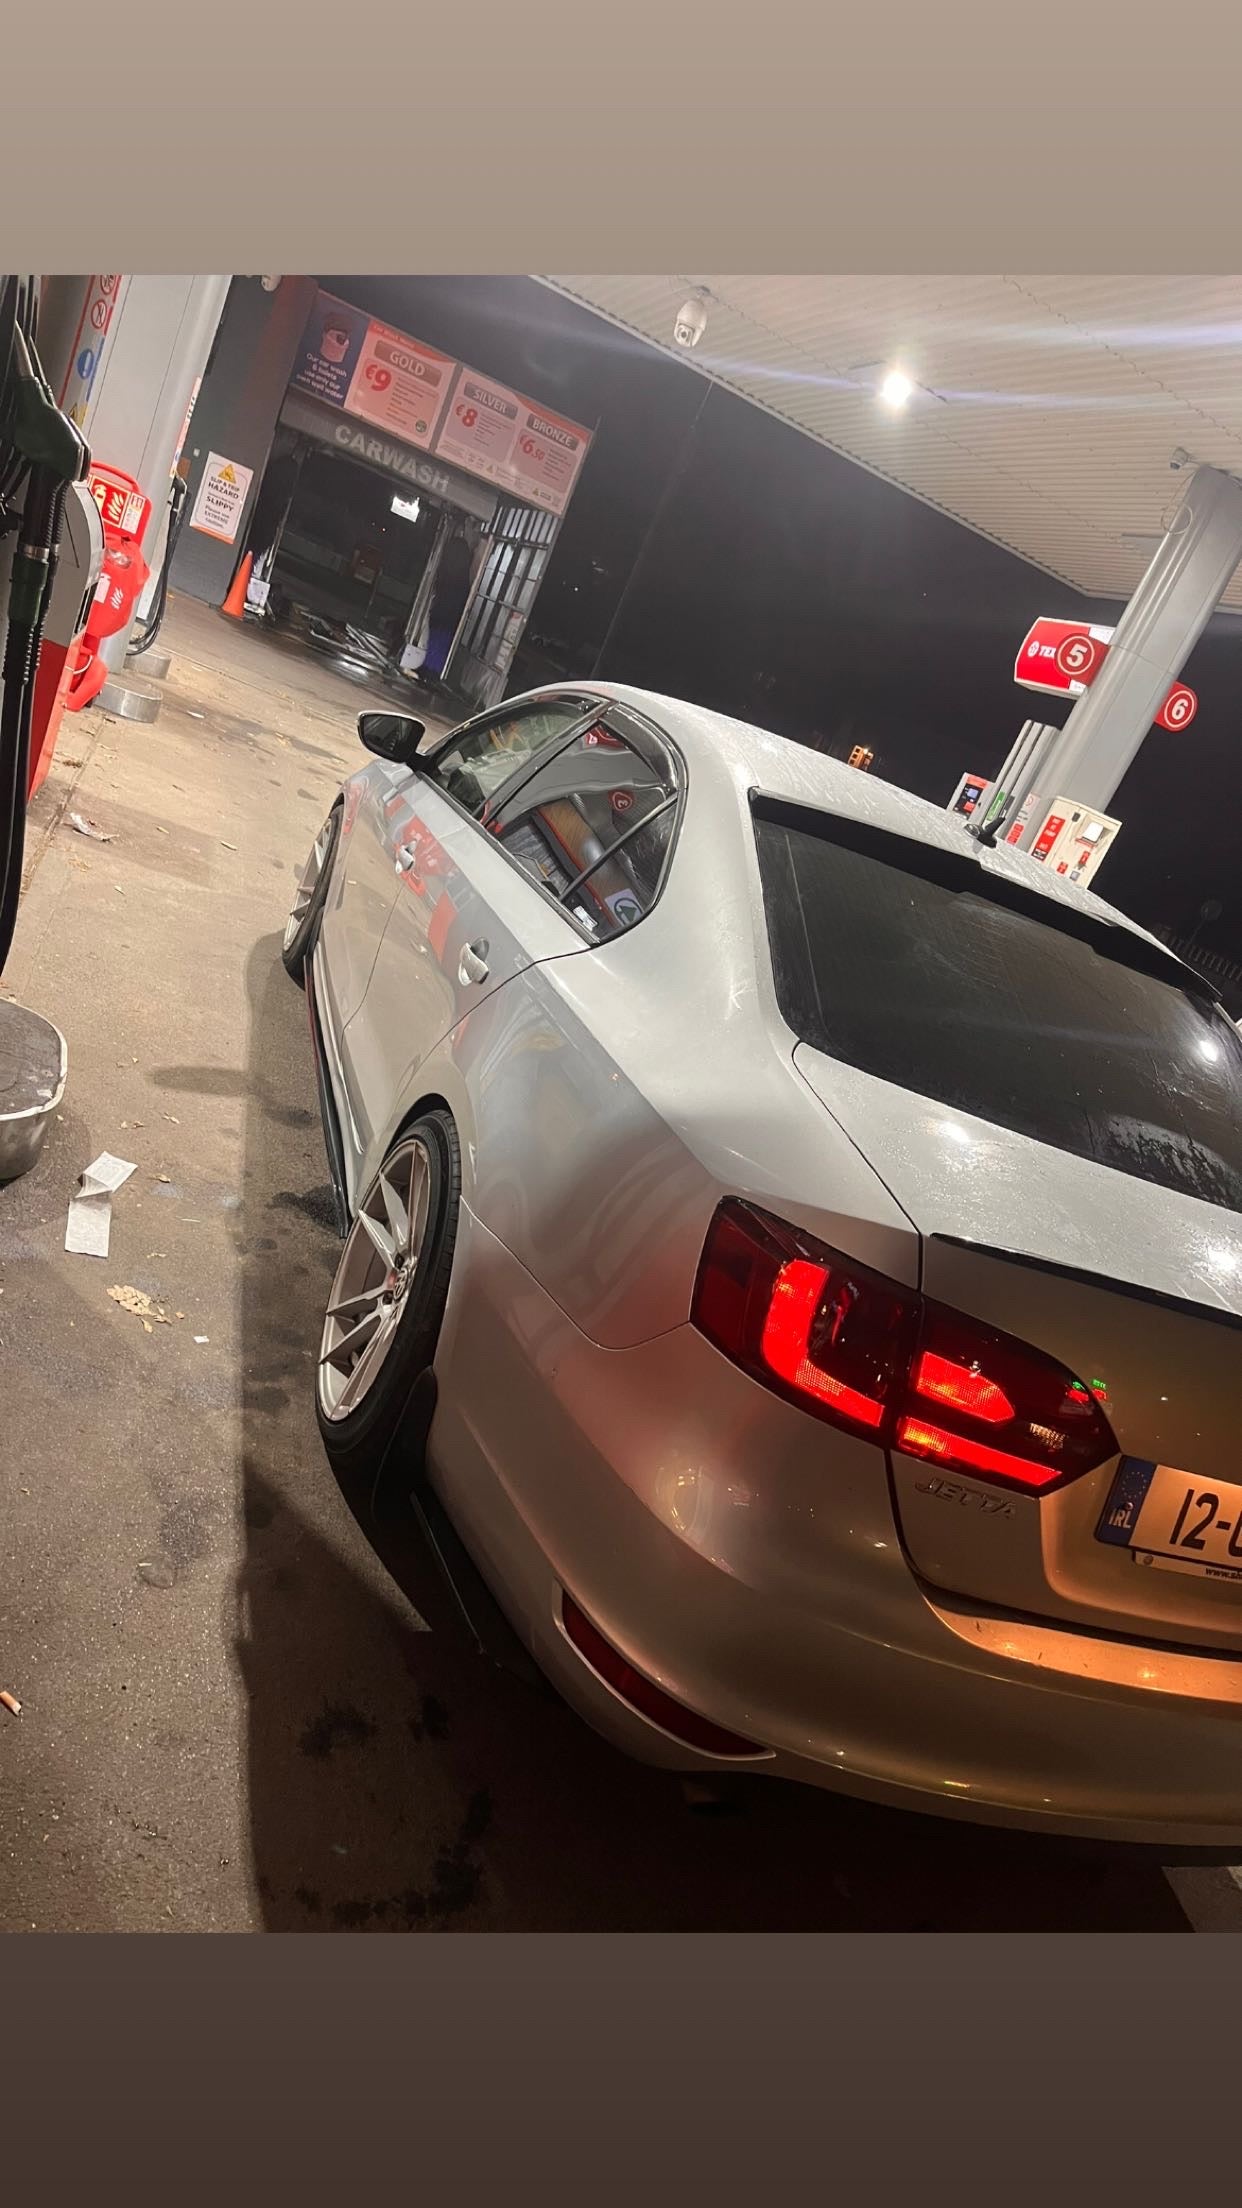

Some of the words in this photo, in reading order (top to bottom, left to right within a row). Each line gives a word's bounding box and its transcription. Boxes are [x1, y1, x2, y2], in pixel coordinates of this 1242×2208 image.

[390, 351, 425, 376] GOLD
[365, 364, 392, 391] €9
[473, 389, 507, 414] SILVER
[533, 418, 574, 446] BRONZE
[335, 424, 450, 492] CARWASH
[208, 482, 239, 500] HAZARD
[210, 476, 222, 485] SLIP
[228, 483, 240, 492] TRIP
[206, 495, 234, 512] SLIPPY
[1066, 643, 1088, 667] 5
[1171, 699, 1189, 720] 6
[914, 1478, 1016, 1519] JETTA
[1109, 1507, 1131, 1528] IRL
